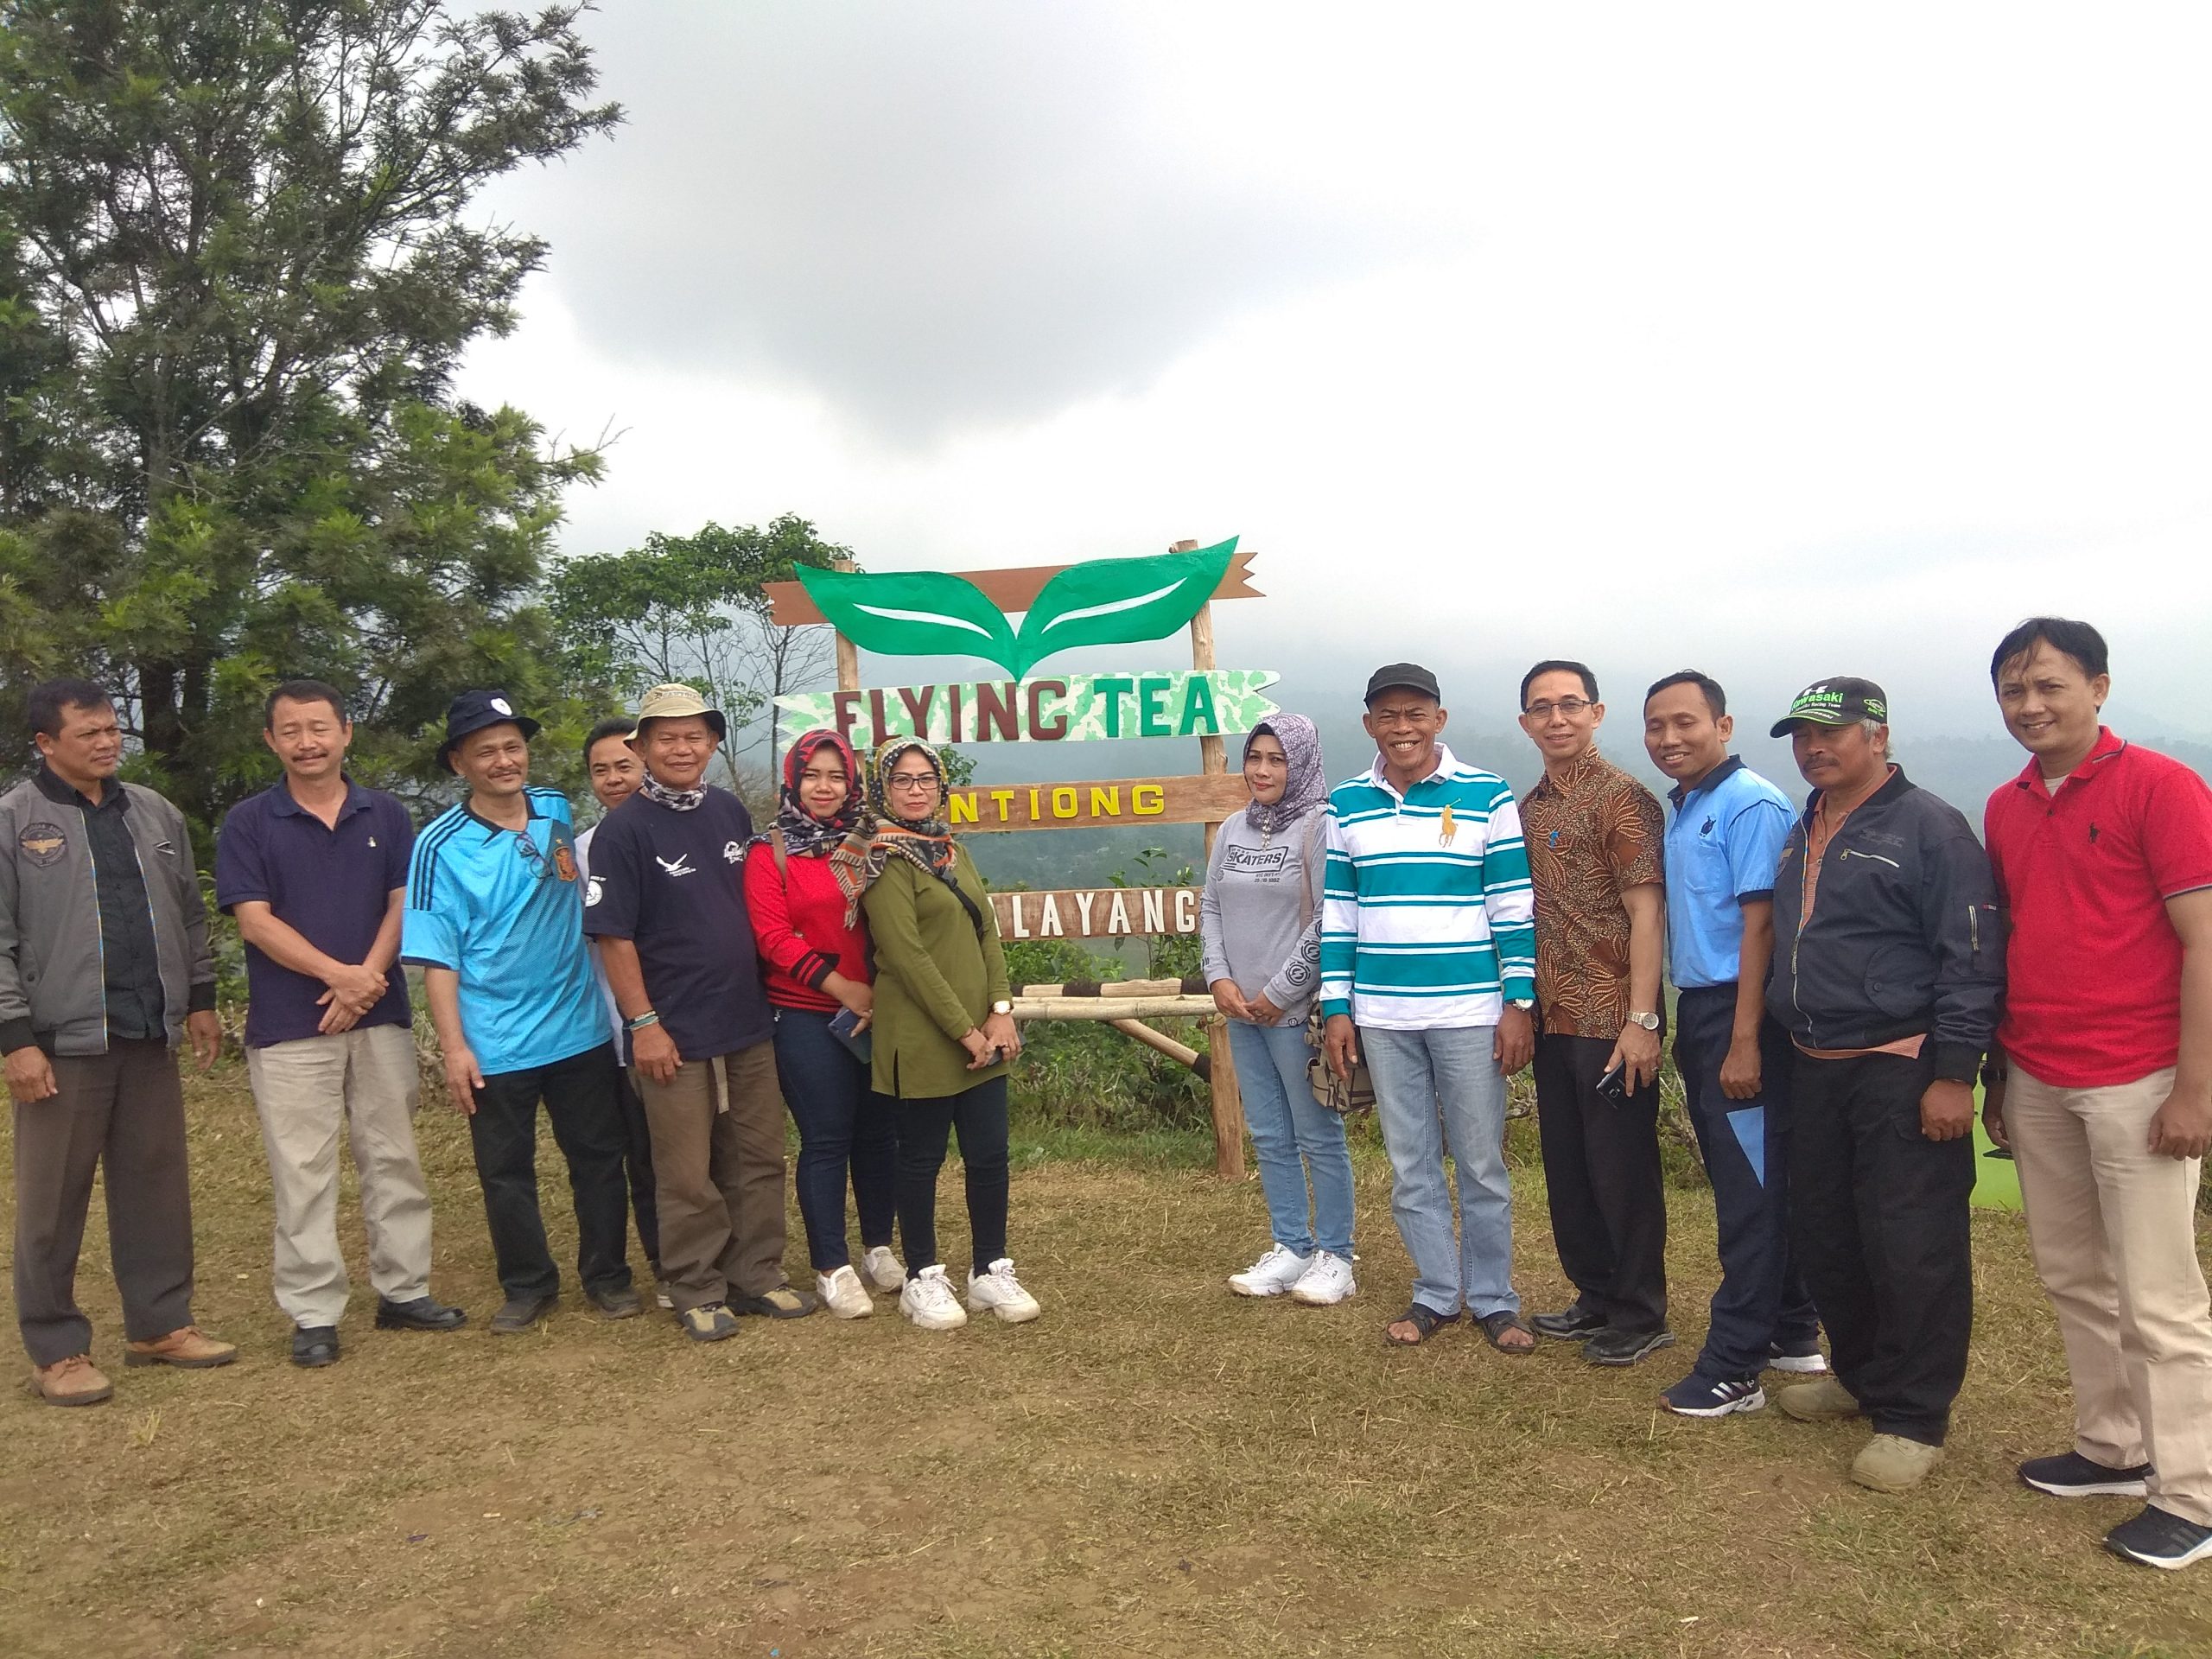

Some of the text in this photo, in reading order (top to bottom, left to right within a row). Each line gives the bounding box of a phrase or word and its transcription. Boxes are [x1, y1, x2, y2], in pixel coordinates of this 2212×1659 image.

[833, 676, 1219, 747] FLYING TEA
[949, 785, 1165, 823] NTIONG
[1227, 851, 1282, 866] SKATERS
